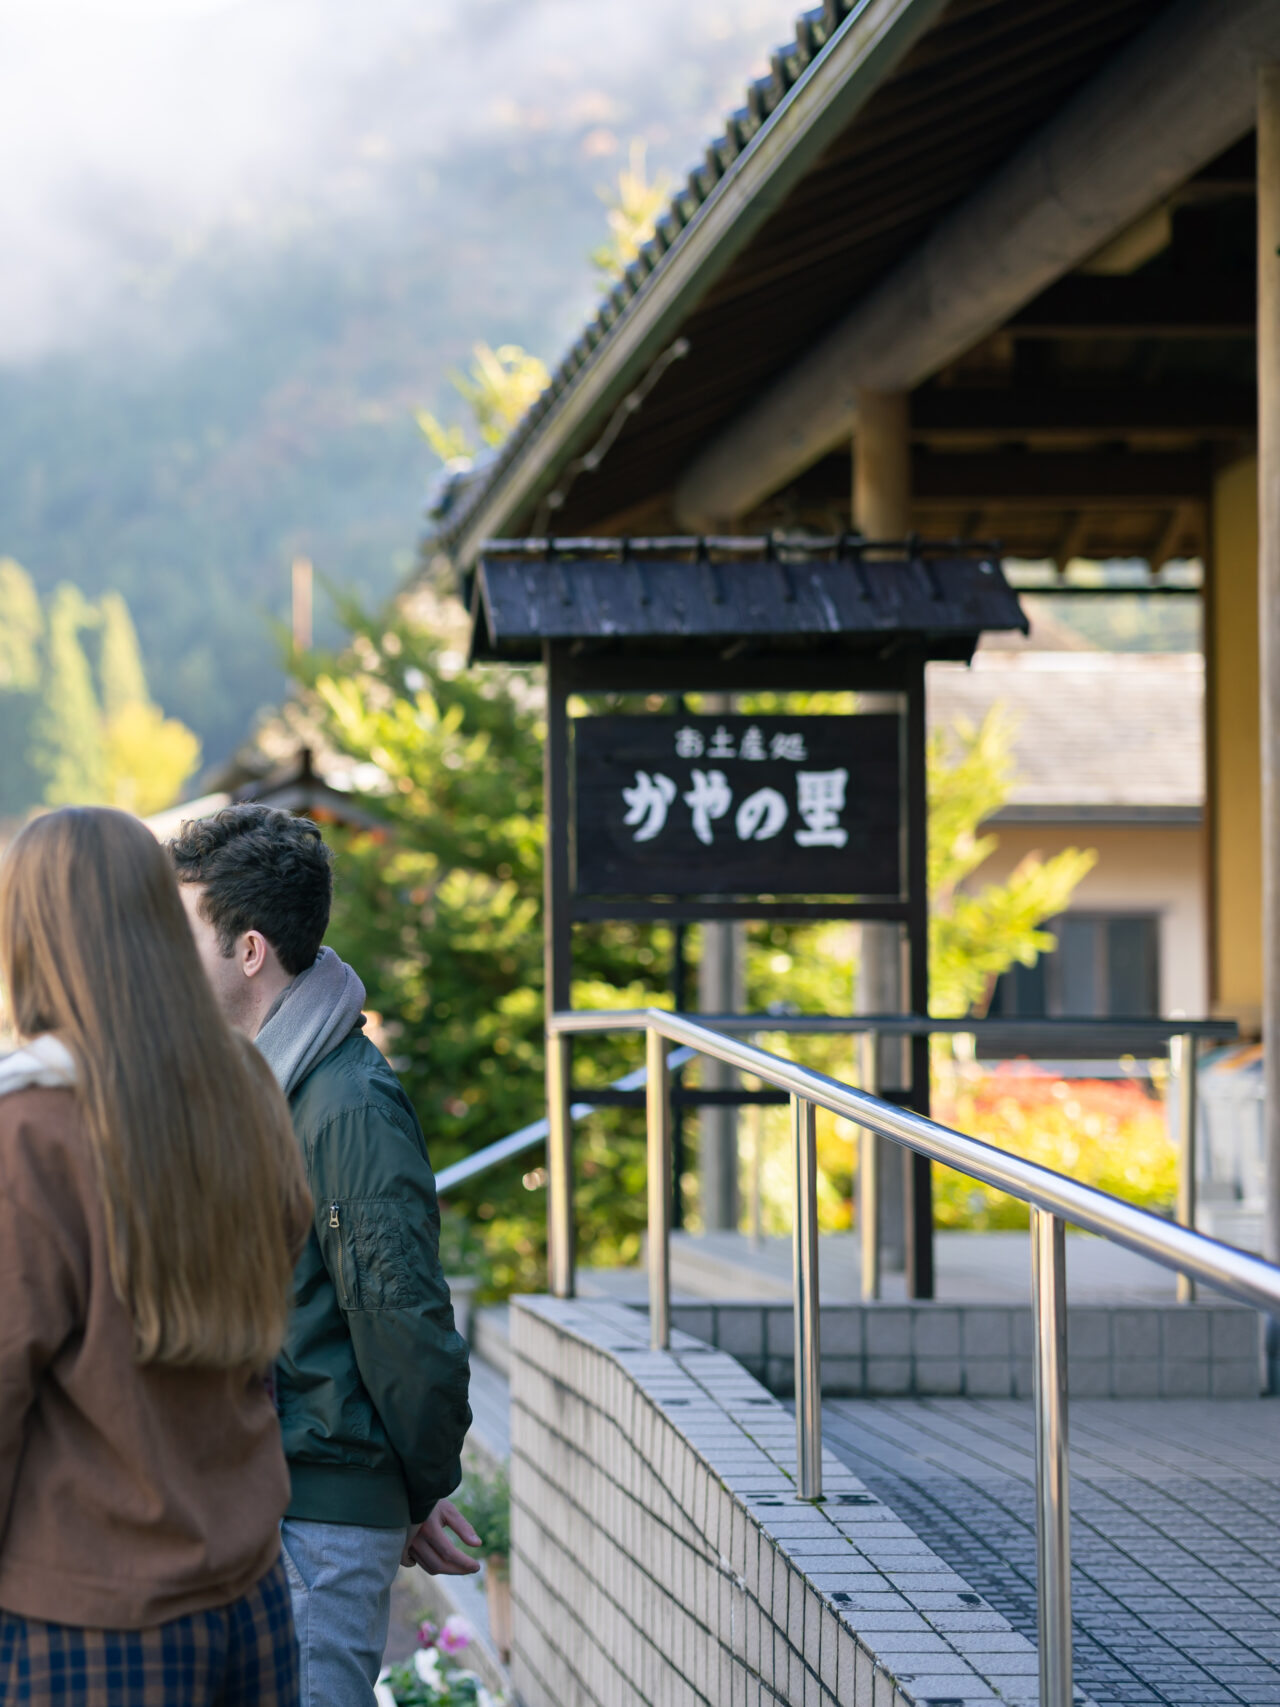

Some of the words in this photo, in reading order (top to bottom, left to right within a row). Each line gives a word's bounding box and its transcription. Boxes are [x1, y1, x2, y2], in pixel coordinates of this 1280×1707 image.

[675, 725, 808, 761] お土産処
[622, 768, 849, 848] かやの里
